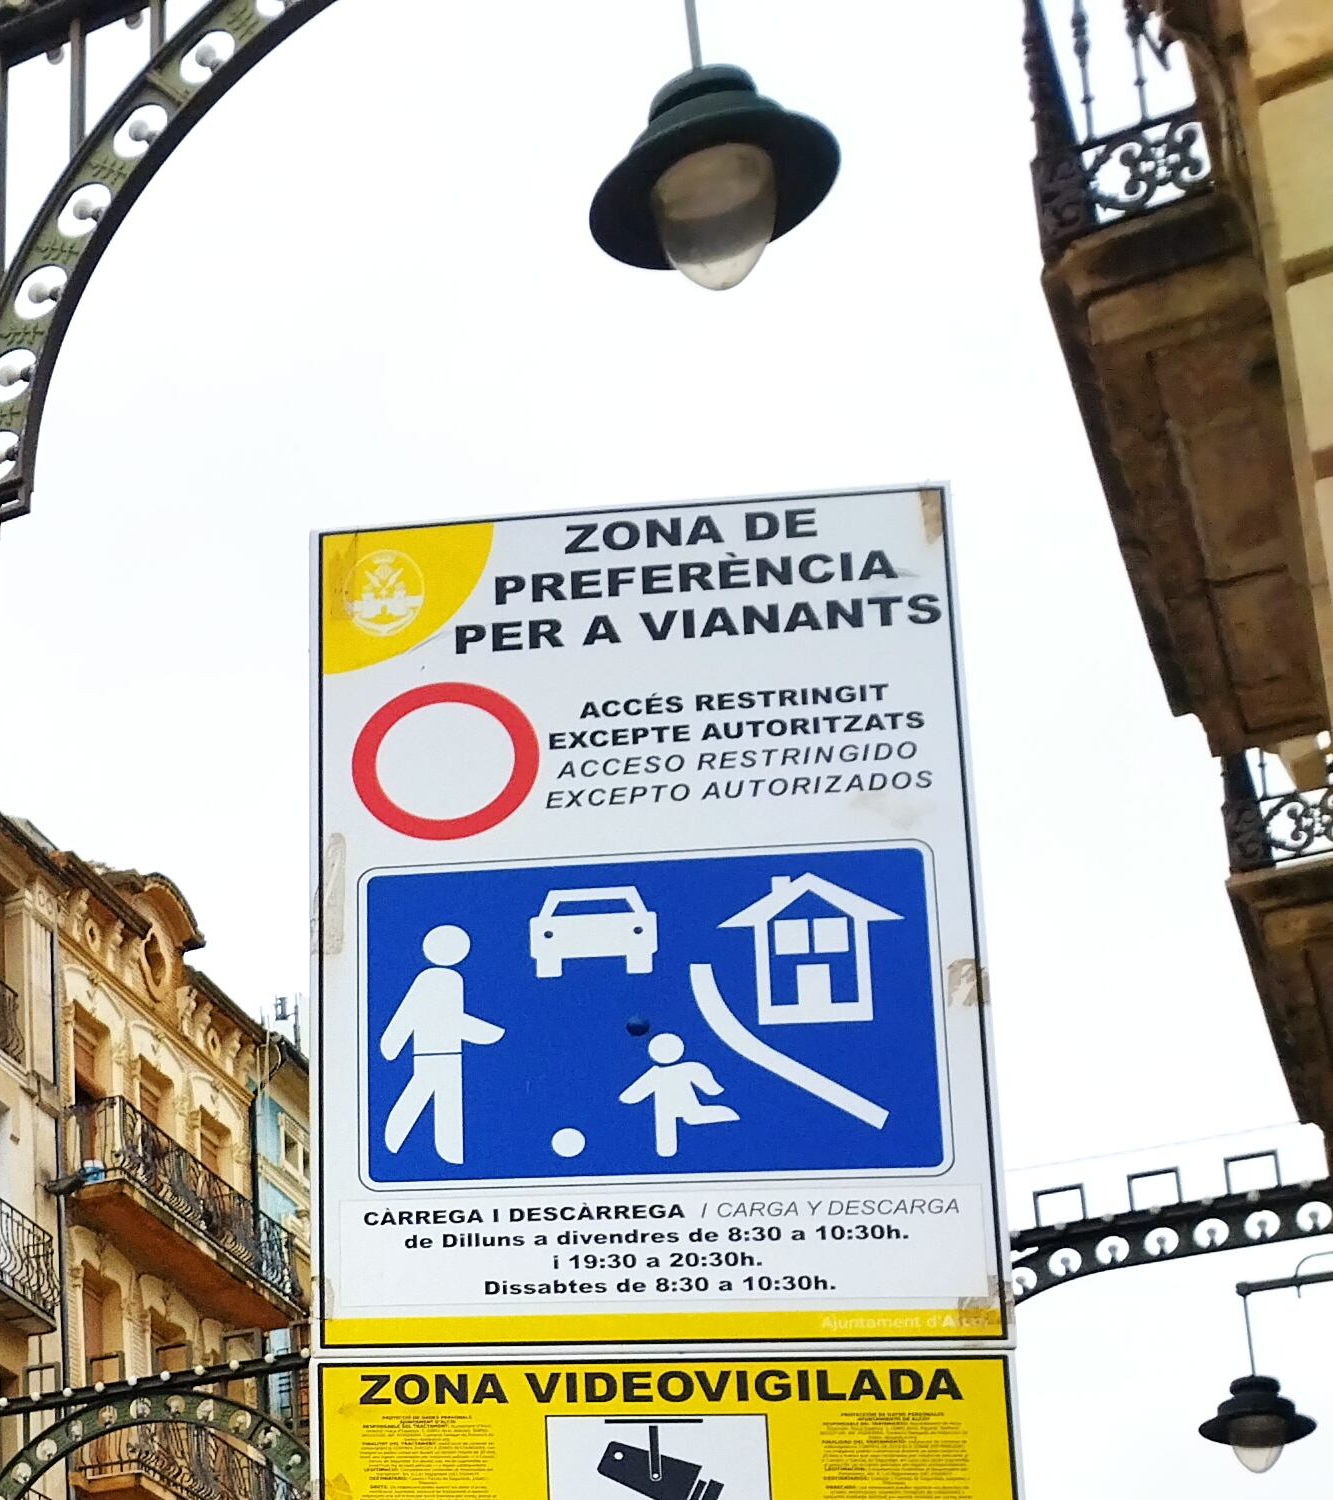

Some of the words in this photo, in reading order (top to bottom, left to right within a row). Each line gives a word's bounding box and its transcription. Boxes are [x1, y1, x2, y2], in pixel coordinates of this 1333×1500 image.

[564, 513, 724, 554] ZONA
[744, 508, 818, 541] DE
[494, 550, 900, 605] PREFERÈNCIA
[455, 618, 564, 655] PER
[582, 614, 621, 646] A
[638, 593, 942, 642] VIANANTS
[579, 694, 684, 719] ACCÉS
[695, 683, 890, 712] RESTRINGIT
[548, 724, 691, 750] EXCEPTE
[701, 710, 926, 741] AUTORITZATS
[556, 754, 685, 779] ACCESO
[697, 740, 918, 771] RESTRINGIDO
[544, 783, 691, 809] EXCEPTO
[701, 770, 933, 800] AUTORIZADOS
[363, 1208, 484, 1226] CÀRREGA
[493, 1208, 499, 1223] I
[508, 1202, 685, 1223] DESCÀRREGA
[717, 1201, 799, 1218] CARGA
[809, 1201, 822, 1216] Y
[828, 1198, 961, 1216] DESCARGA
[404, 1235, 433, 1249] de
[443, 1232, 525, 1249] Dilluns
[534, 1234, 548, 1247] a
[556, 1228, 679, 1246] divendres
[688, 1227, 719, 1243] de
[728, 1226, 782, 1242] 8:30
[791, 1228, 806, 1241] a
[815, 1224, 909, 1240] 10:30h.
[553, 1254, 560, 1270] i
[568, 1253, 637, 1270] 19:30
[645, 1256, 661, 1269] a
[670, 1251, 763, 1268] 20:30h.
[484, 1279, 607, 1296] Dissabtes
[616, 1277, 647, 1293] de
[655, 1276, 709, 1292] 8:30
[718, 1278, 733, 1291] a
[742, 1275, 836, 1291] 10:30h.
[822, 1316, 922, 1331] Ajuntament
[359, 1373, 509, 1405] ZONA
[525, 1368, 964, 1404] VIDEOVIGILADA
